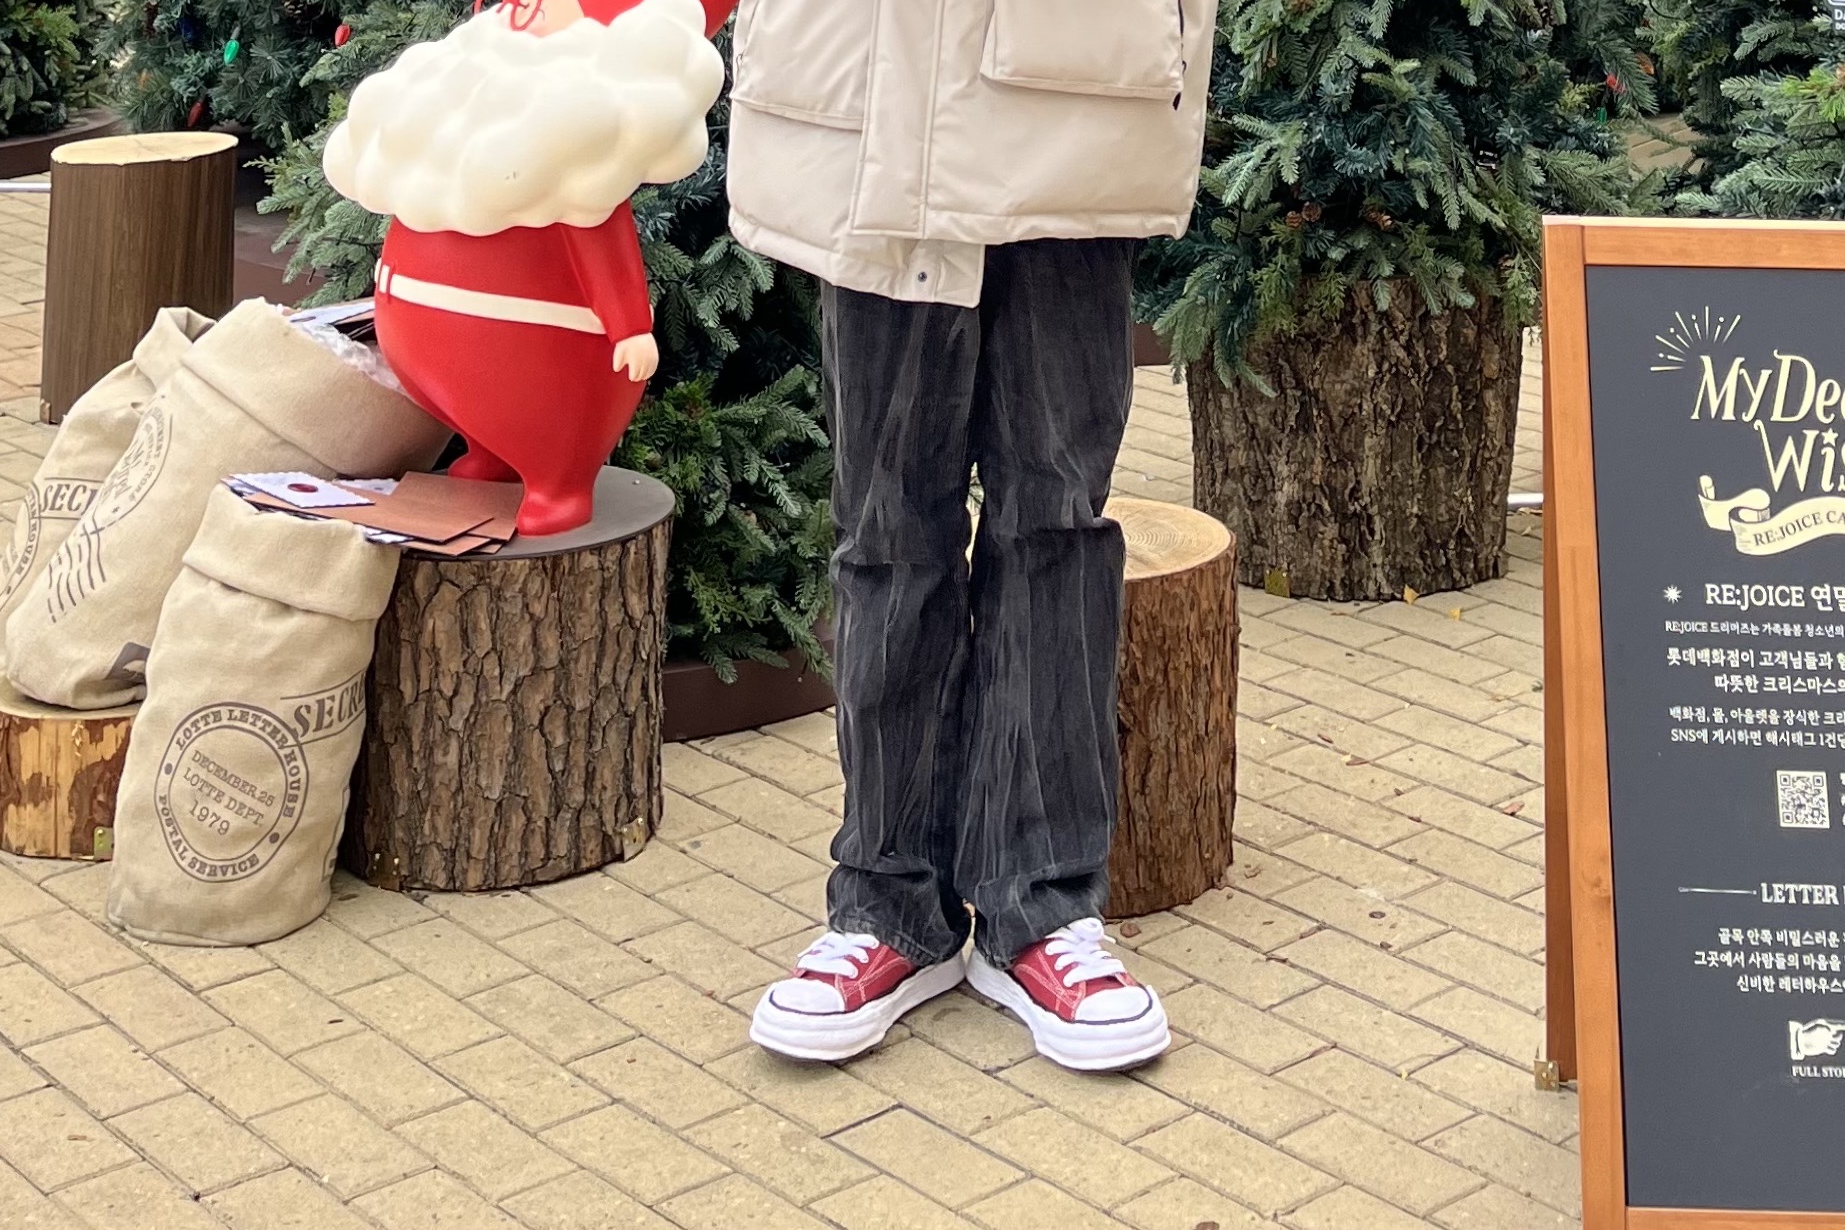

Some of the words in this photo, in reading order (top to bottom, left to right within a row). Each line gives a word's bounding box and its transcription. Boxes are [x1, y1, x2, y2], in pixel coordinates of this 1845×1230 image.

[1770, 349, 1845, 424] De
[1753, 511, 1823, 546] RE:JOICE
[1705, 583, 1805, 611] RE:JOICE
[1665, 620, 1708, 634] RE:JOICE
[1667, 647, 1755, 668] 롯데백화점이
[1759, 650, 1834, 670] 고객님들과
[1714, 674, 1759, 693] 따뜻한
[1669, 706, 1711, 723] 백화점,
[1730, 708, 1780, 725] 아울렛을
[1783, 709, 1820, 726] 장식한
[1671, 728, 1708, 744] SNS에
[1712, 729, 1762, 746] 게시하면
[1765, 731, 1817, 747] 해시태그
[176, 709, 223, 750] LOTTE
[226, 709, 290, 750] LETTER
[283, 749, 301, 818] HOUSE
[183, 767, 225, 803] LOTTE
[189, 799, 231, 836] 1979
[159, 794, 187, 860] POSTAL
[187, 853, 260, 877] SERVICE
[1760, 882, 1839, 905] LETTER
[1718, 927, 1745, 945] 골목
[1747, 928, 1773, 946] 안쪽
[1776, 929, 1840, 948] 비밀스러운
[1694, 950, 1746, 968] 그곳에서
[1749, 951, 1800, 970] 사람들의
[1802, 953, 1842, 972] 마음을
[1737, 974, 1776, 993] 신비한
[1779, 976, 1845, 994] 레터하우스
[1792, 1065, 1821, 1078] FULL
